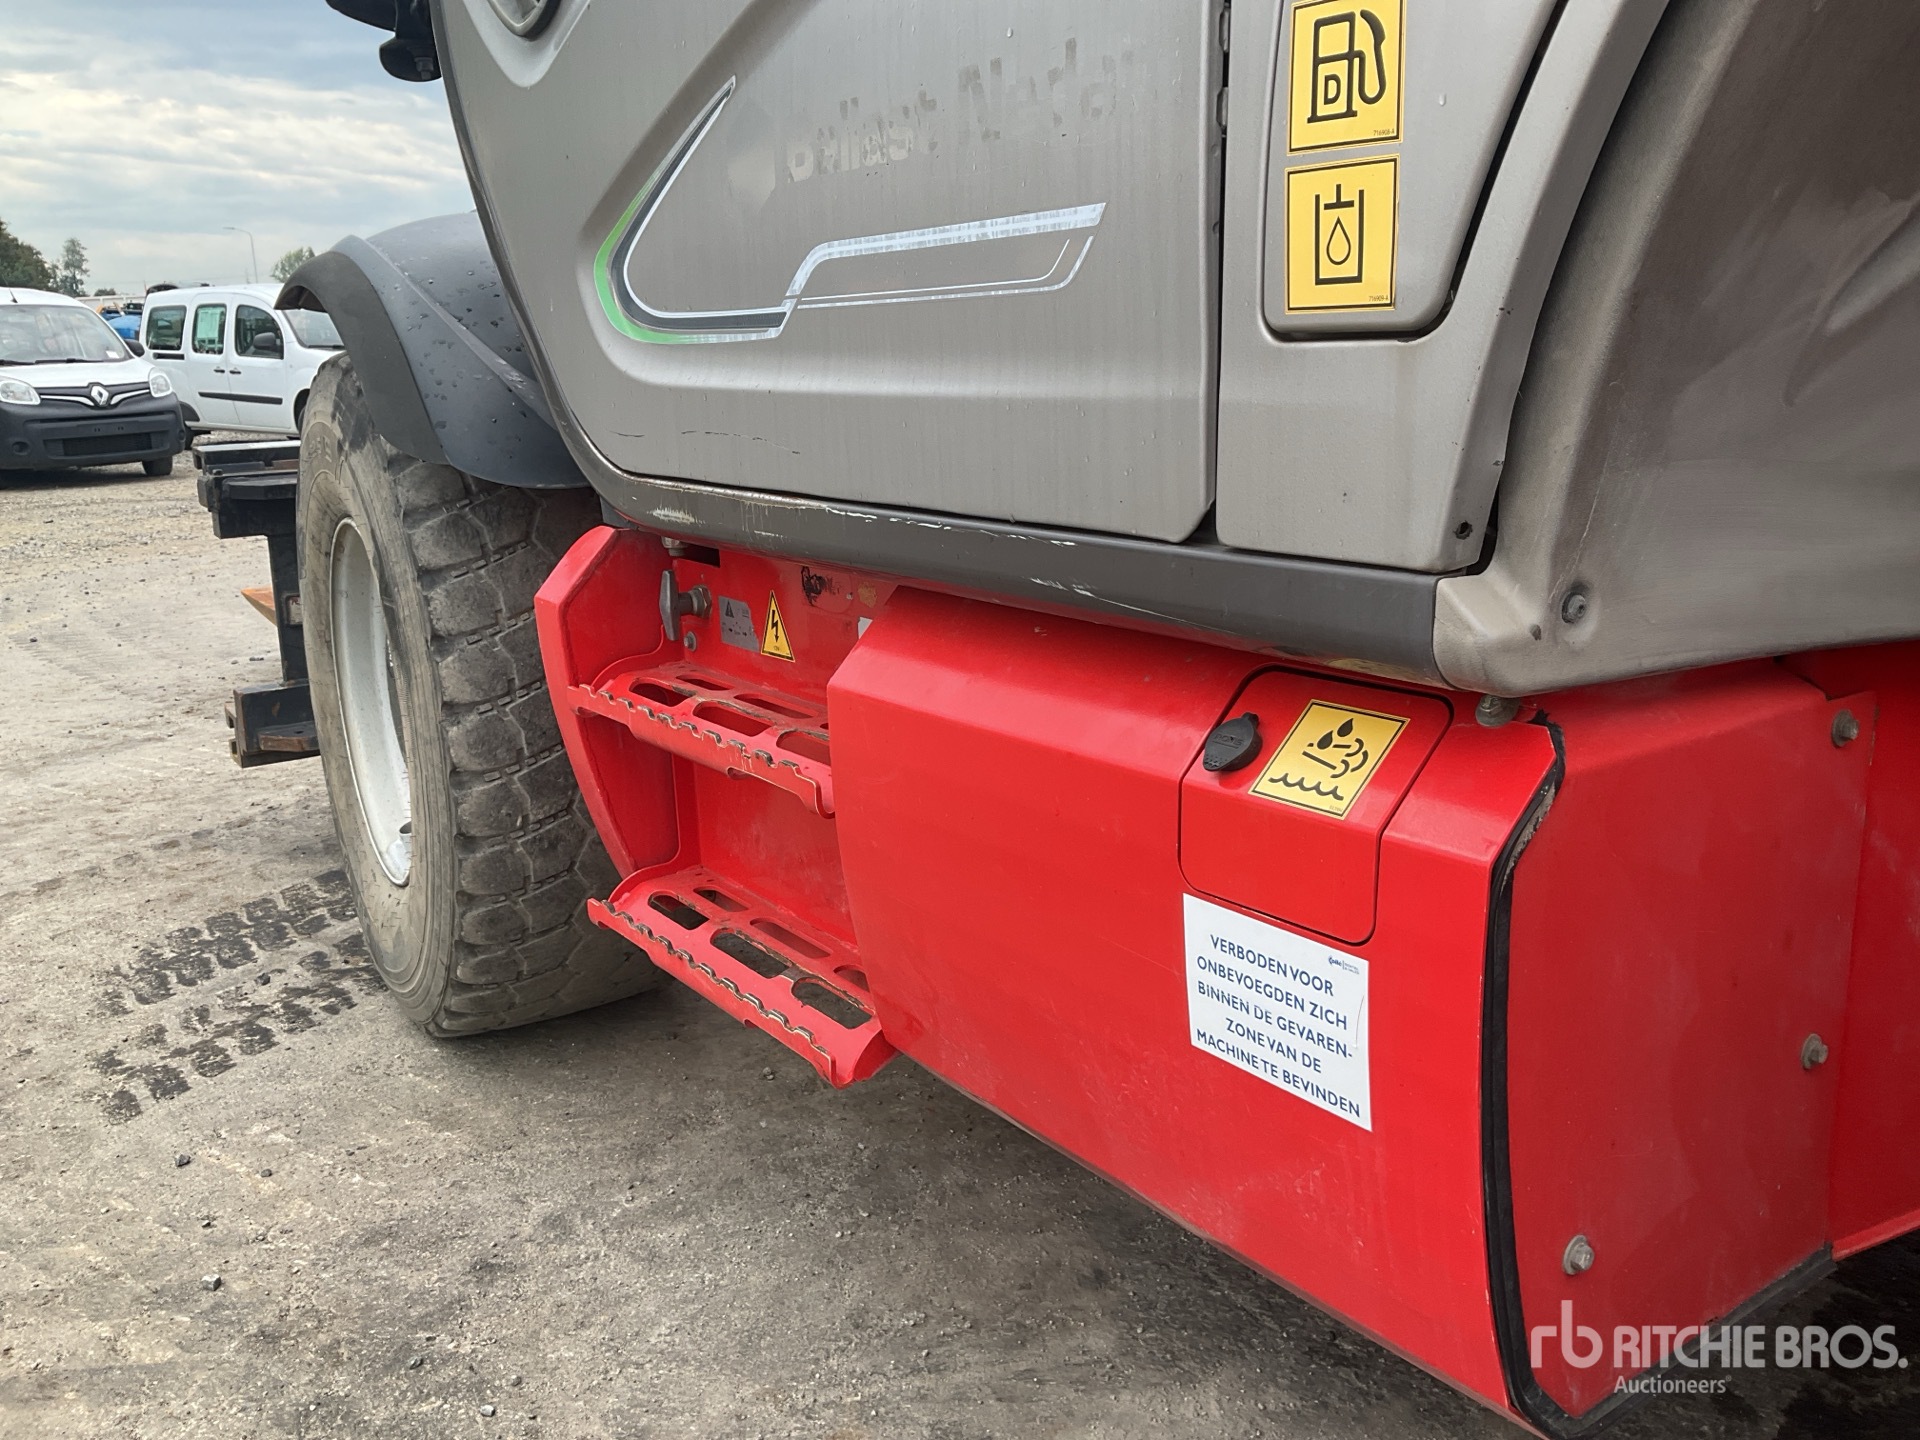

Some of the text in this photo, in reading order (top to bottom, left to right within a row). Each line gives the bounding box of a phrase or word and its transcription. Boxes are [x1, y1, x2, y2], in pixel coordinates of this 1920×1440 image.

[1323, 74, 1341, 105] D
[1197, 956, 1305, 1012] ONBEVOEGDEN
[1309, 1001, 1347, 1030] ZICH
[1210, 934, 1287, 978] VERBODEN
[1289, 966, 1334, 997] VOOR
[1198, 980, 1353, 1058] BINNEN DE GEVAREN-
[1225, 1017, 1322, 1073] ZONE VAN DE
[1197, 1029, 1360, 1118] MACHINE TE BEVINDEN
